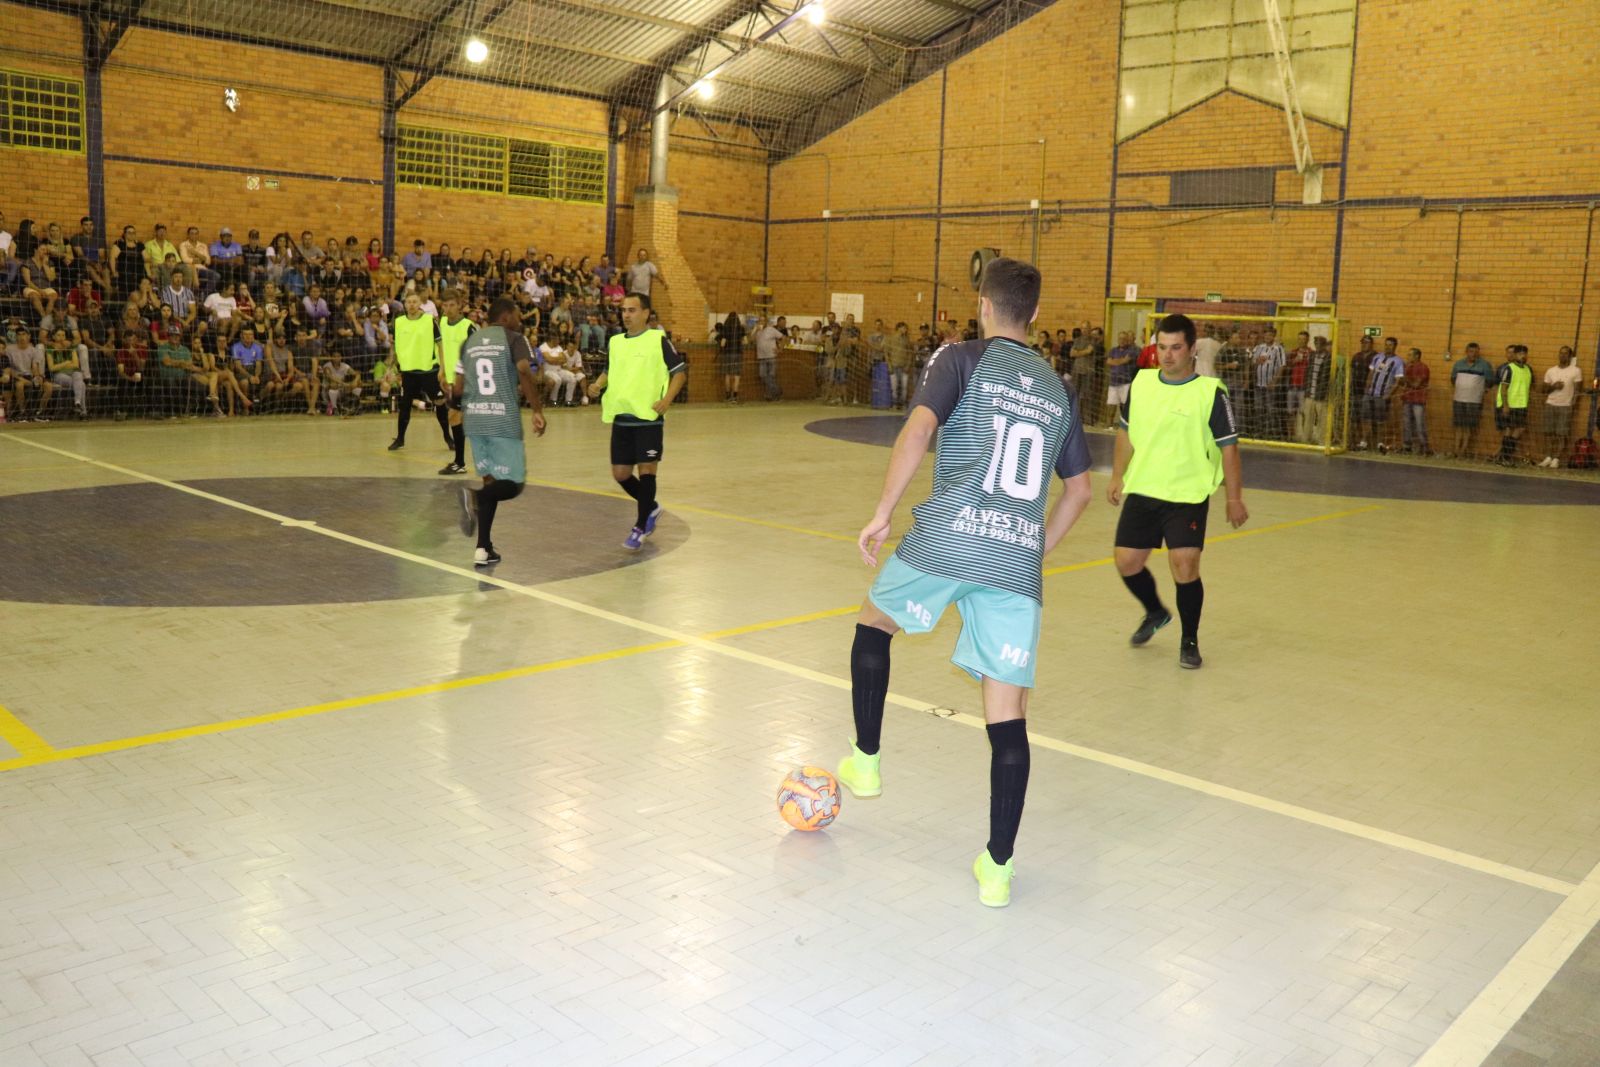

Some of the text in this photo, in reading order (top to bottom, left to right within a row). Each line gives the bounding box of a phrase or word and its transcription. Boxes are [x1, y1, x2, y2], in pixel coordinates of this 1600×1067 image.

[475, 358, 496, 395] 8
[981, 382, 1062, 416] SUPERMERCADO
[982, 414, 1044, 501] 10
[958, 505, 1012, 529] ALVES
[978, 526, 987, 536] 9
[906, 600, 932, 628] MB
